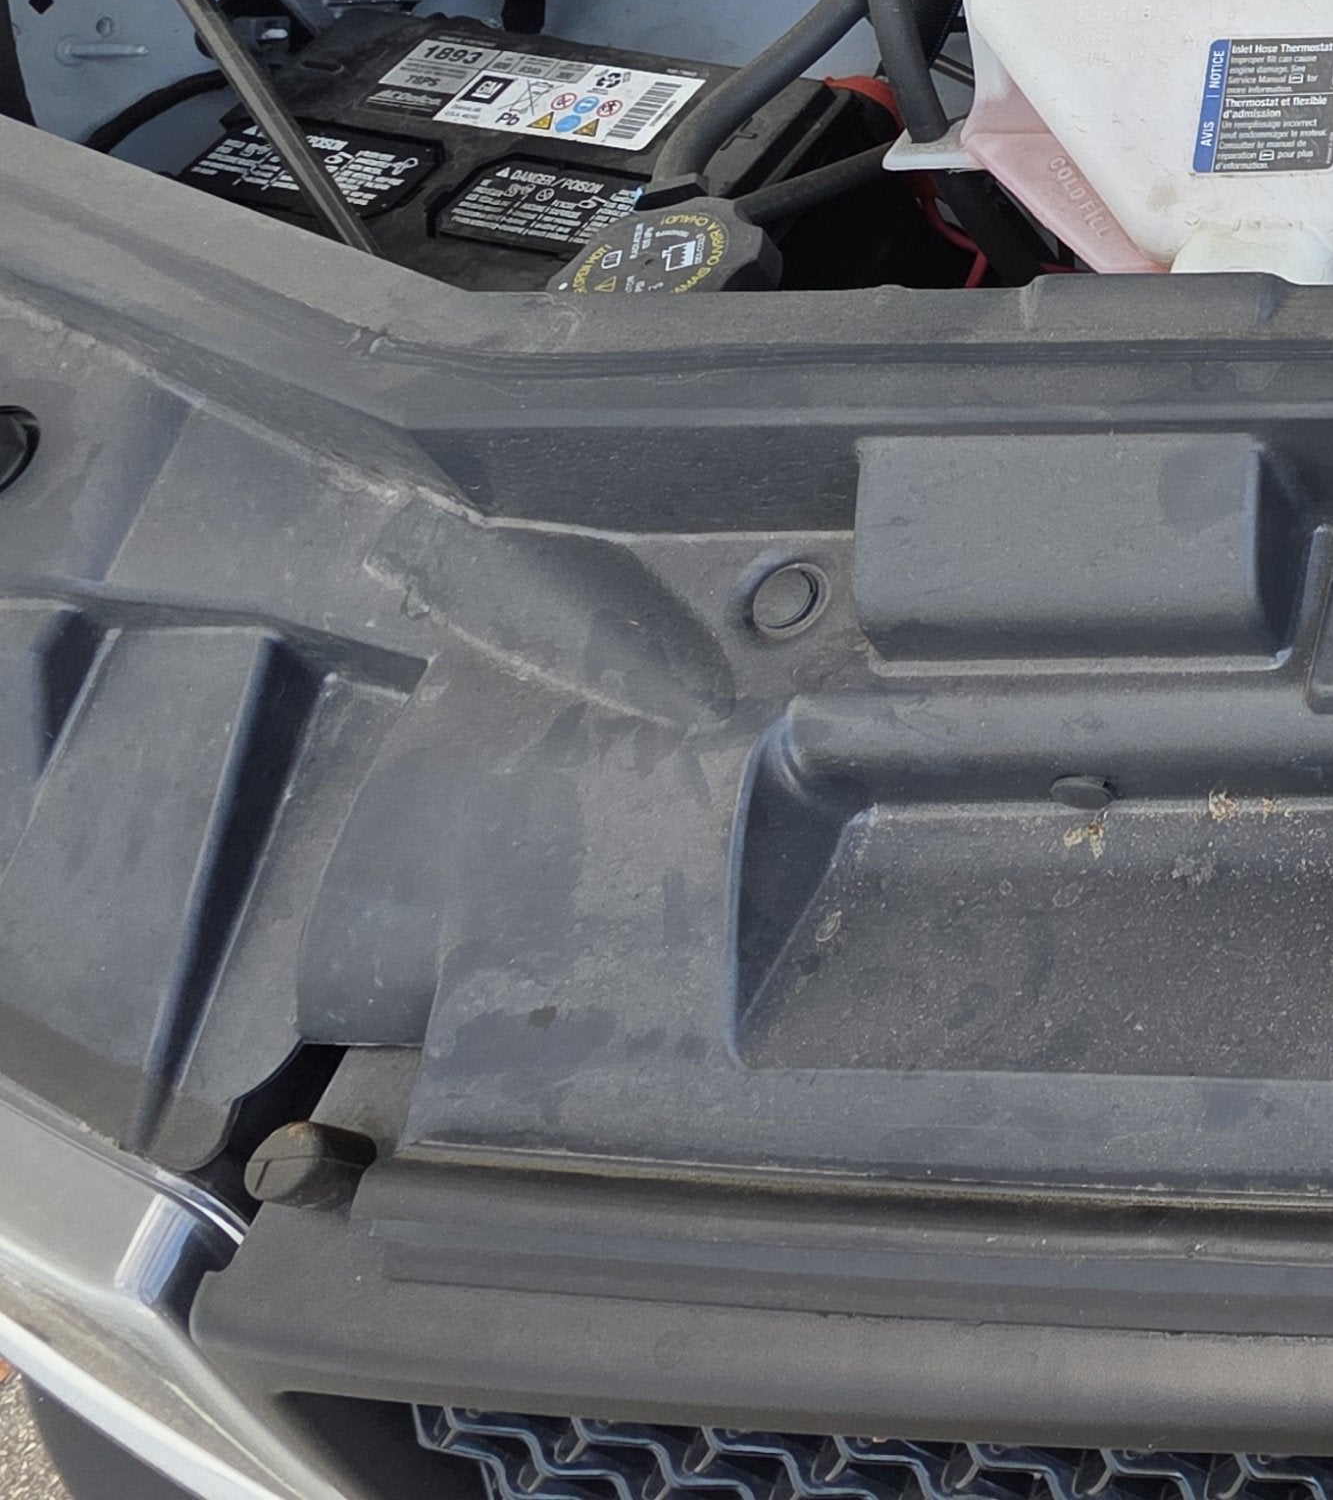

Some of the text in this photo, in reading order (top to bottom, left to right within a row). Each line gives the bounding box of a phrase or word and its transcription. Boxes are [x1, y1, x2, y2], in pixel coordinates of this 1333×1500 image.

[1232, 43, 1333, 54] Inlet Hose Thermostat
[423, 45, 483, 64] 1893
[1231, 56, 1265, 64] Improper
[1294, 55, 1317, 63] cause
[1209, 50, 1225, 89] NOTICE
[1229, 65, 1306, 75] engine damage. See
[1227, 74, 1318, 84] Service Manual for
[1225, 95, 1327, 108] Thermostat et flexible
[495, 112, 520, 126] Pb
[1223, 109, 1281, 119] d'admission
[1283, 119, 1317, 127] incorrect
[1200, 121, 1215, 147] AVIS
[1220, 131, 1237, 140] peut
[1239, 131, 1289, 139] endommager
[1219, 141, 1255, 149] Consulter
[1266, 140, 1295, 148] manuel
[1277, 151, 1296, 160] pour
[1297, 150, 1314, 158] plus
[1216, 162, 1268, 171] d'information.
[510, 169, 556, 186] DANGER
[562, 178, 605, 193] POISON
[1049, 157, 1110, 239] COLD FILL
[572, 265, 592, 287] OPEN
[670, 267, 712, 293] AMAIS
